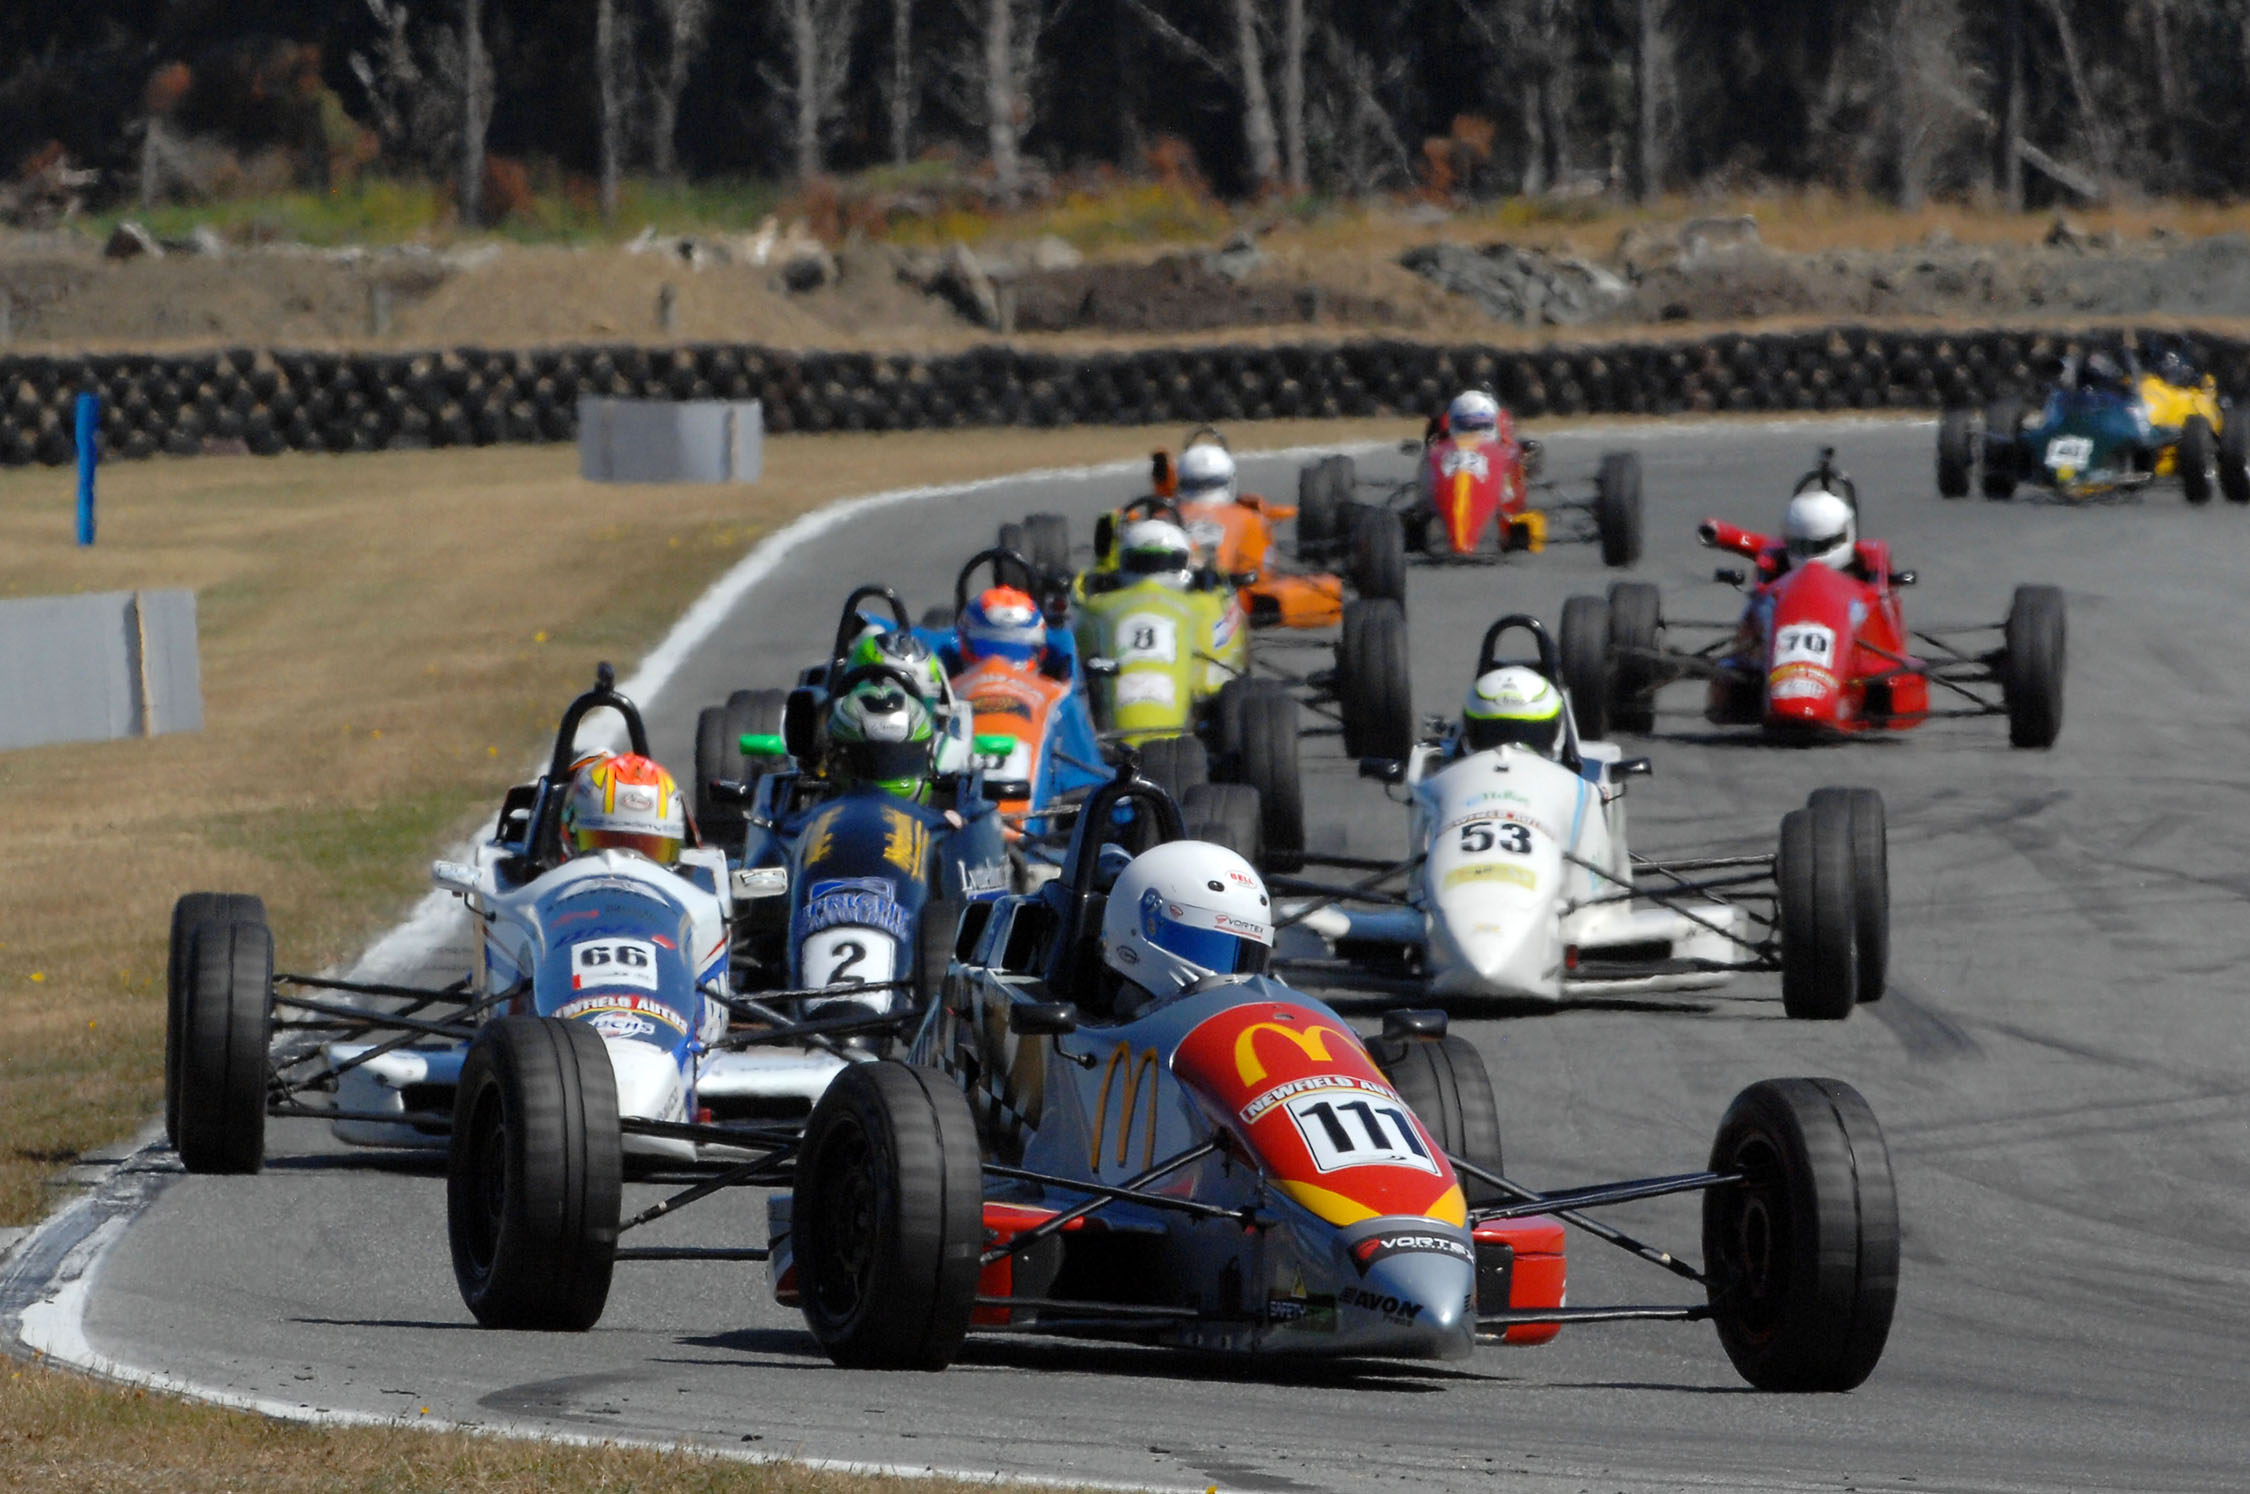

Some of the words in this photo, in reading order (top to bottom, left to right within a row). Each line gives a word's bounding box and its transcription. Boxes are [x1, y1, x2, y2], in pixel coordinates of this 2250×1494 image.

[1461, 821, 1533, 854] 53
[1230, 872, 1254, 885] BELL
[581, 946, 648, 967] 66
[828, 941, 867, 984] 2
[592, 1020, 654, 1034] UCHS
[1246, 1076, 1354, 1117] NEWFIELD
[1299, 1100, 1428, 1159] 111
[1379, 1236, 1475, 1264] VORTEX
[1353, 1290, 1424, 1318] AVON
